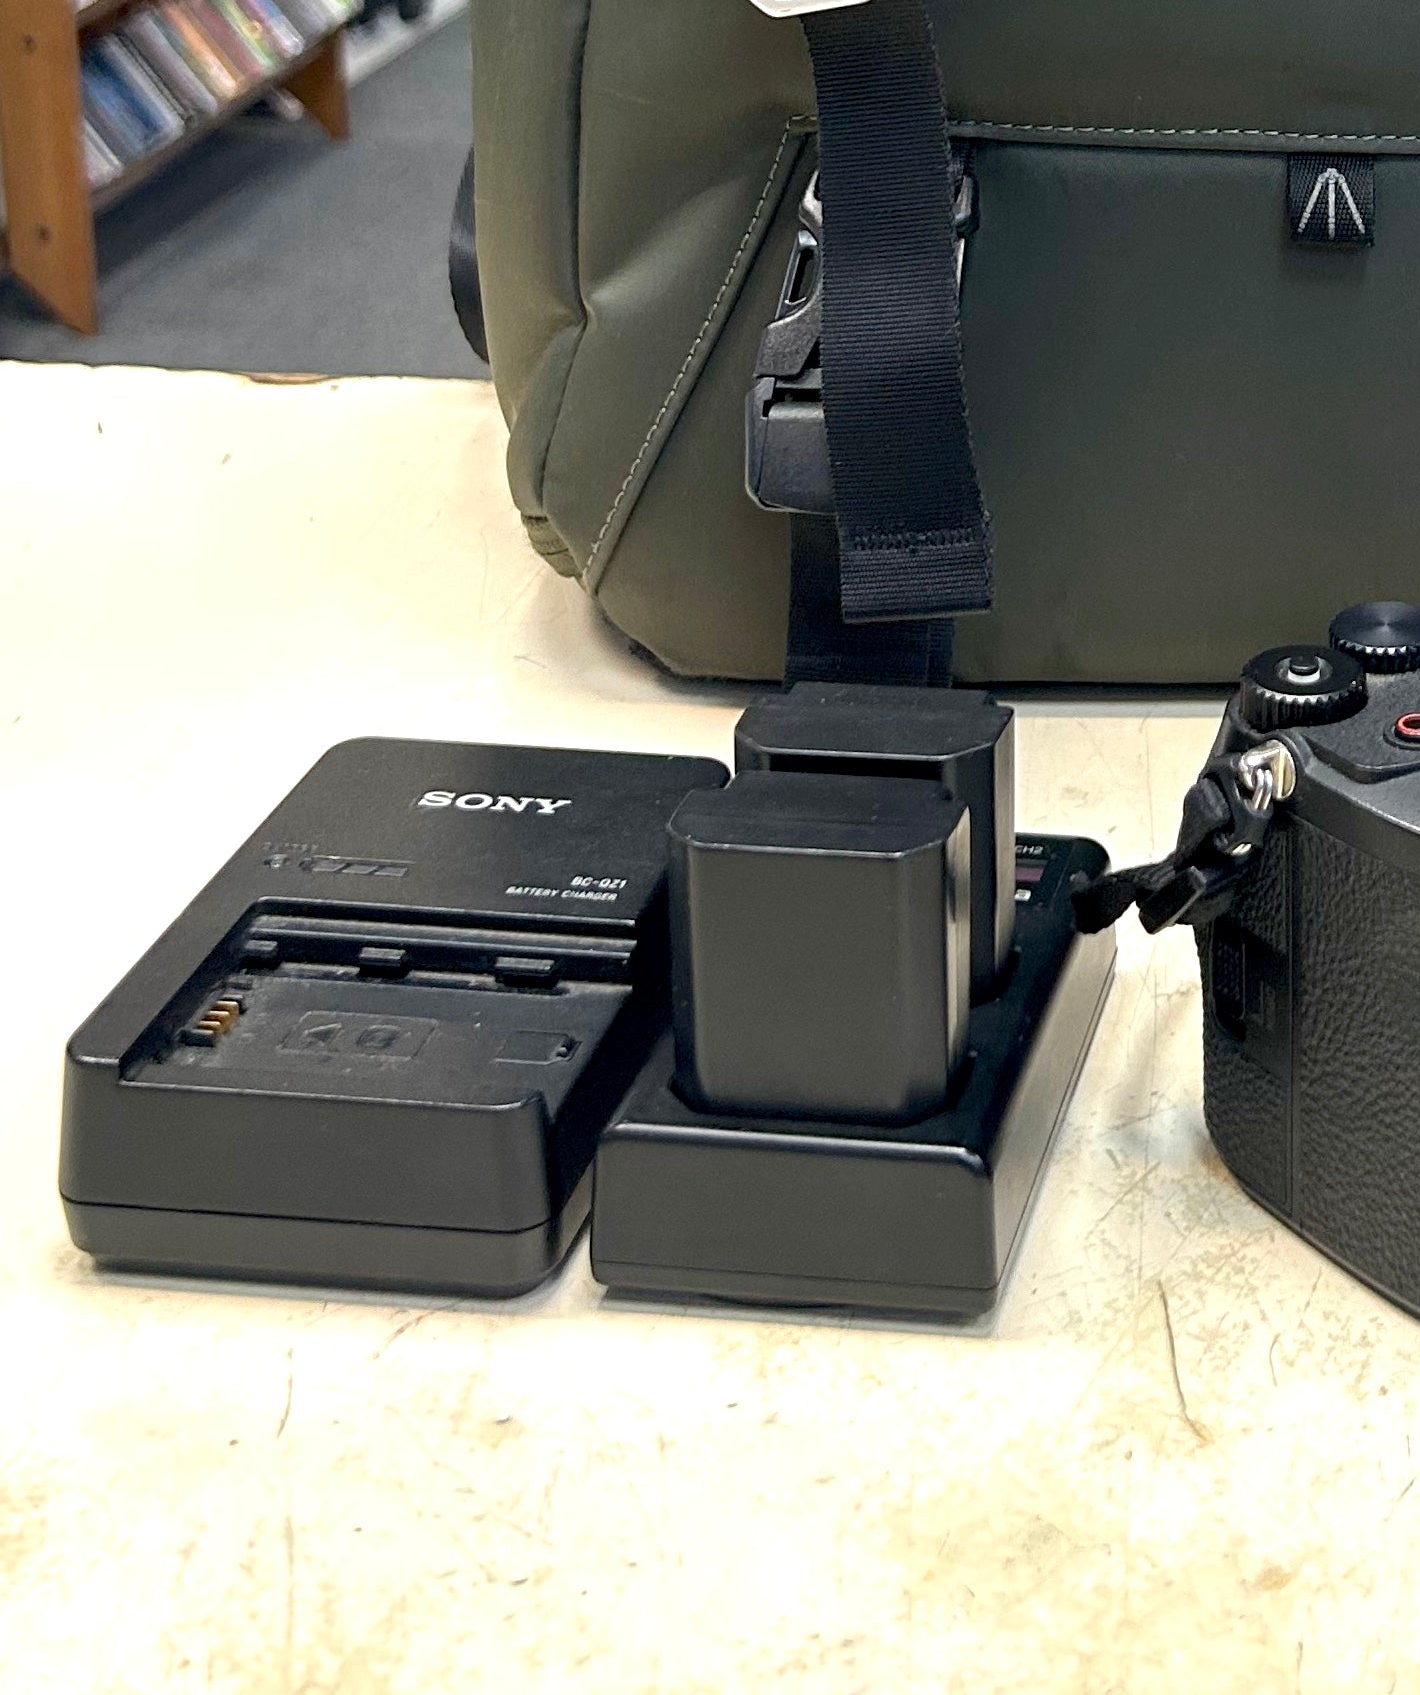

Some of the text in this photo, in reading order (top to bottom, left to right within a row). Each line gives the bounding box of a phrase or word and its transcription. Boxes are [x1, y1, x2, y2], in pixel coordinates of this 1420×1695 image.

[417, 790, 573, 815] SONY
[505, 886, 618, 902] BATTERY CHARGER
